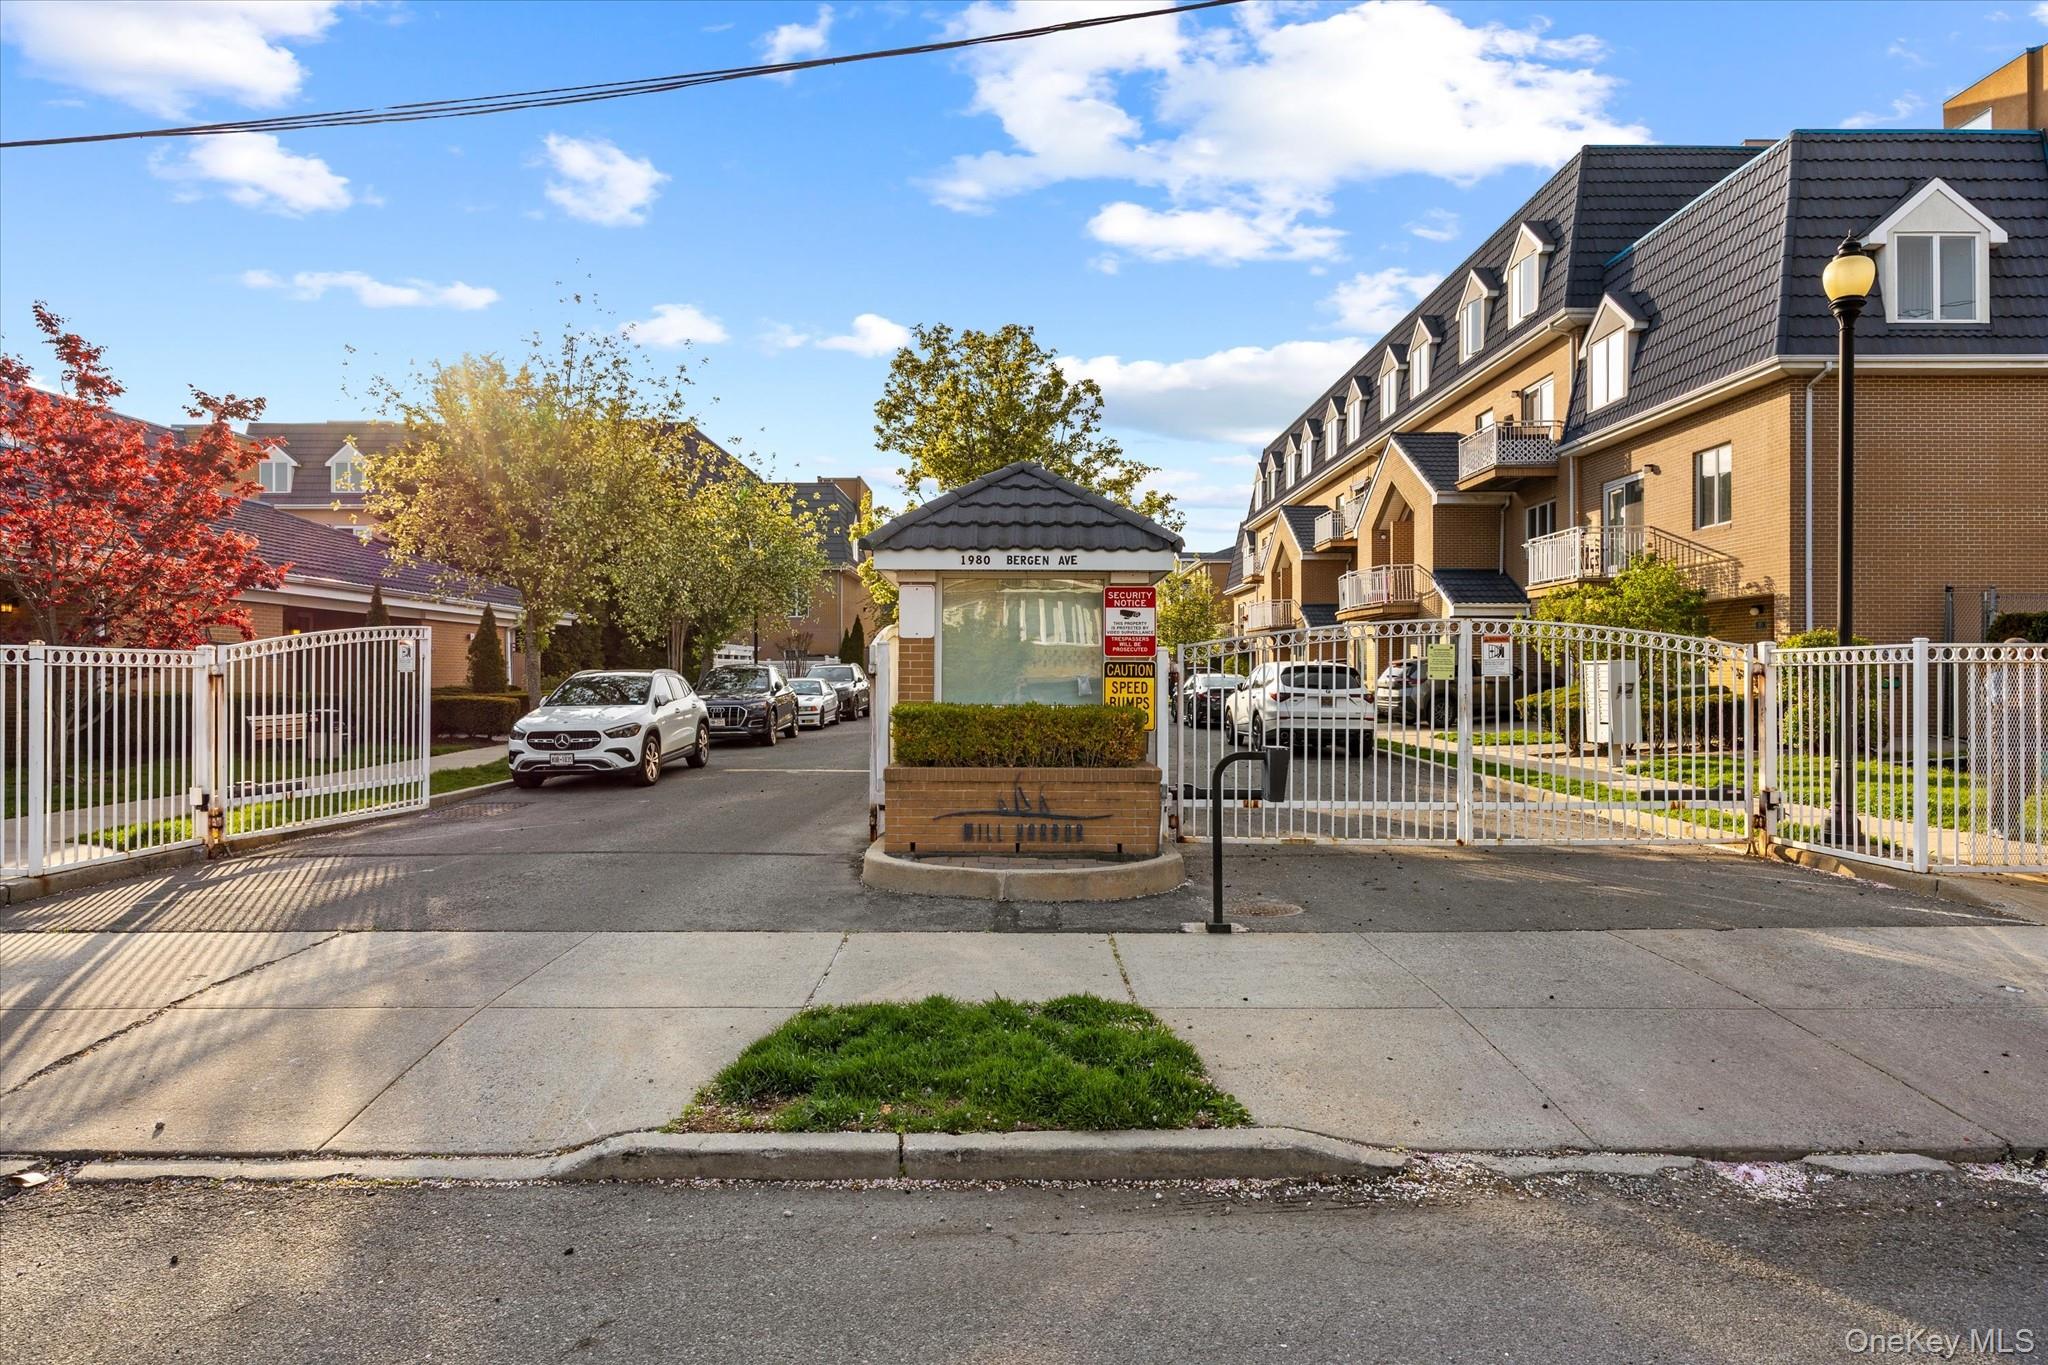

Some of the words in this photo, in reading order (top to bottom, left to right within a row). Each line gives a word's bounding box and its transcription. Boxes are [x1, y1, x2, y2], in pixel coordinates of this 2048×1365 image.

[961, 555, 991, 565] 1980
[1006, 555, 1050, 565] BERGEN
[1058, 555, 1078, 565] AVE
[1107, 591, 1153, 600] SECURITY
[1113, 599, 1147, 607] NOTICE
[1106, 663, 1153, 676] CAUTION
[1111, 681, 1148, 694] SPEED
[963, 823, 1002, 842] MILL
